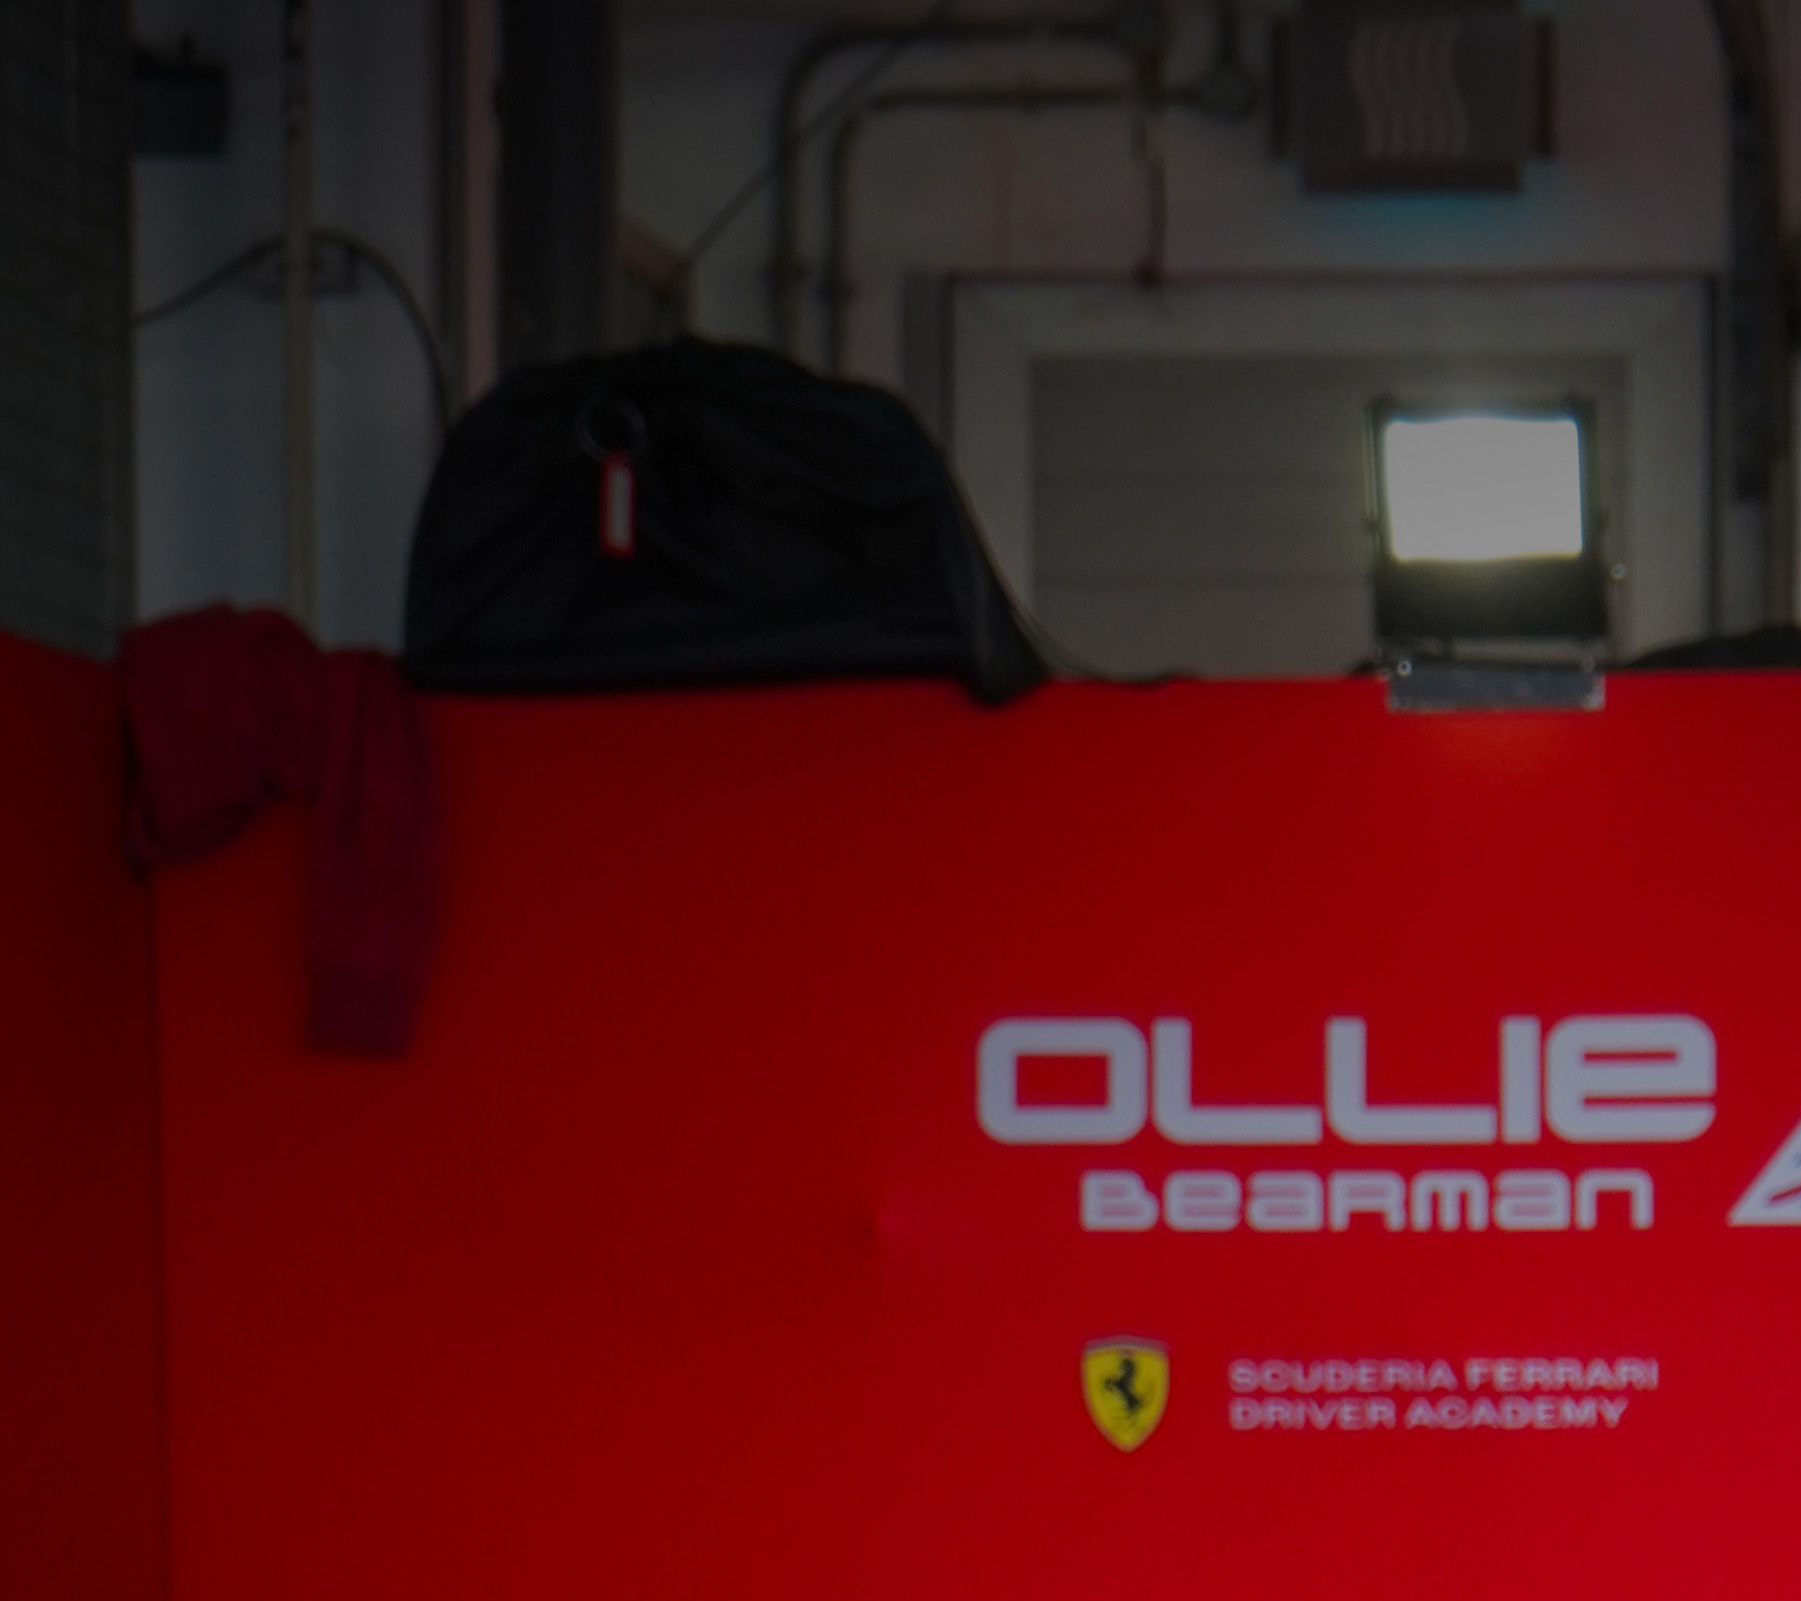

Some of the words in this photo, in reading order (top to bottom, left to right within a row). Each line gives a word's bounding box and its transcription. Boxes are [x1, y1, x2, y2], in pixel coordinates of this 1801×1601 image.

[1228, 1359, 1457, 1392] SCUDERIA
[1466, 1357, 1659, 1391] FERRARI
[1228, 1397, 1396, 1431] DRIVER
[1404, 1396, 1629, 1430] ACADEMY
